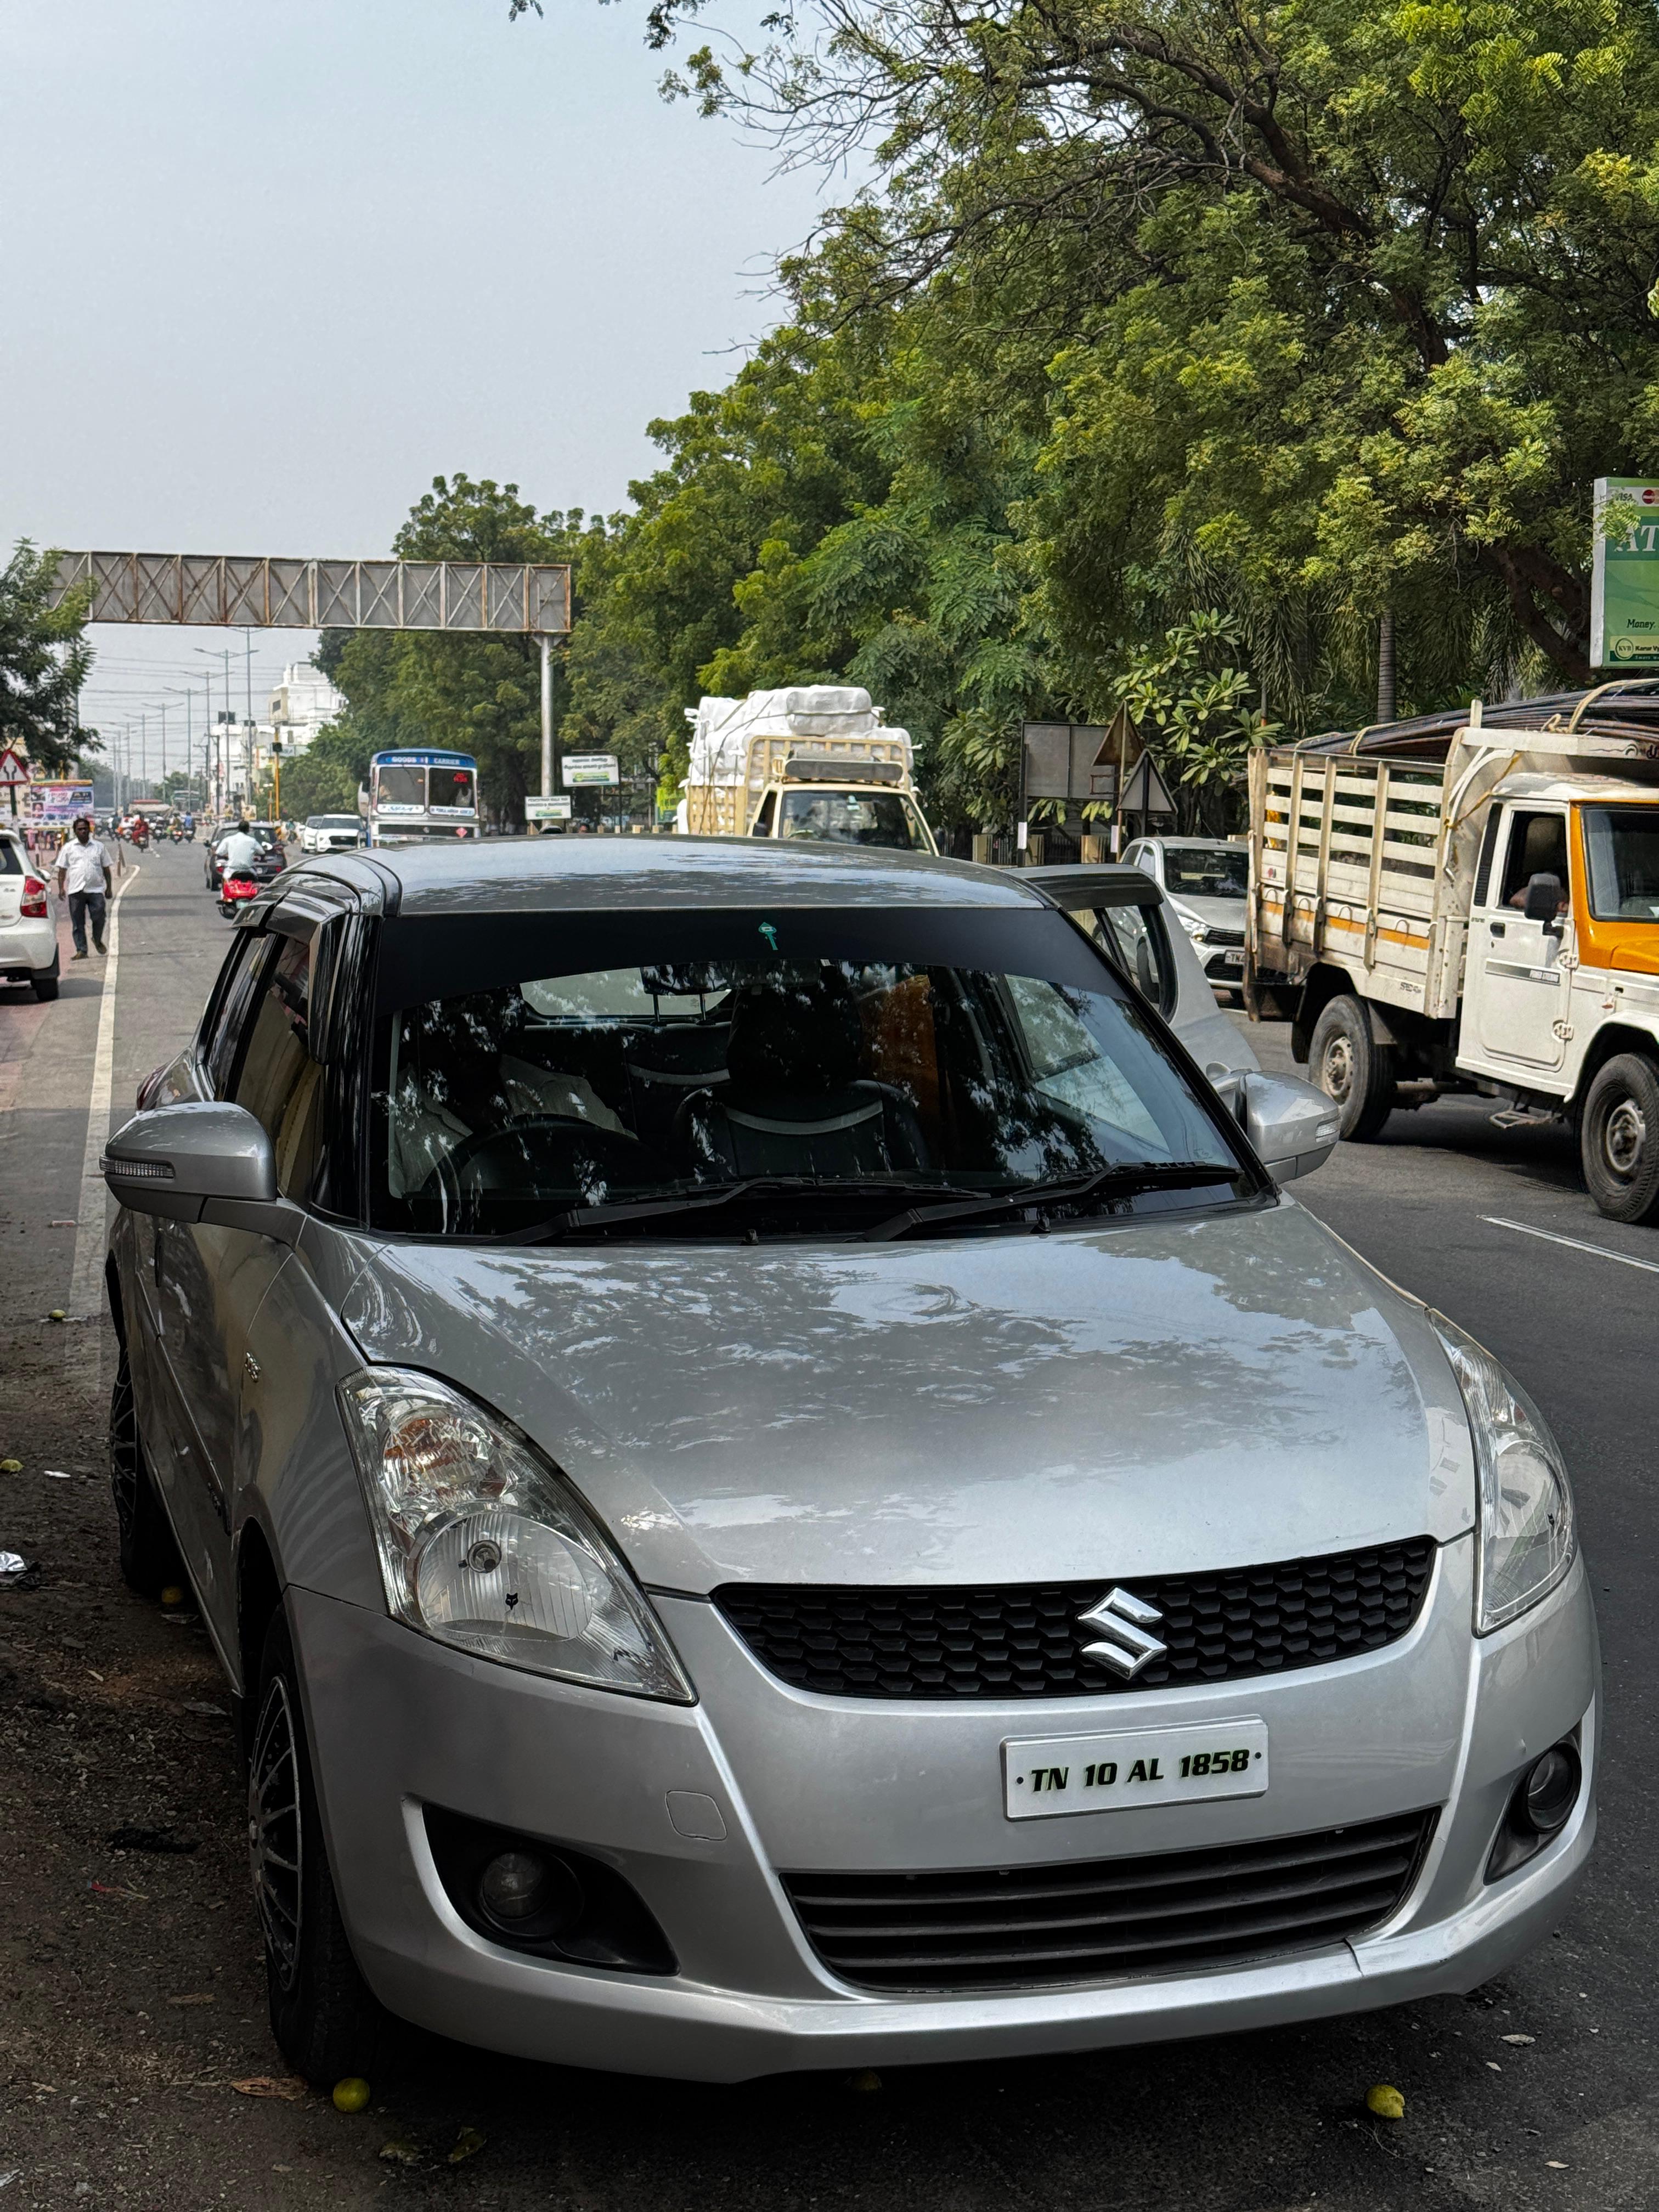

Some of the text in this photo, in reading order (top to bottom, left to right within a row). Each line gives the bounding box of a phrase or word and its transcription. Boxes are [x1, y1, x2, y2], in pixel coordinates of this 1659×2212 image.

[1627, 618, 1656, 630] Money.
[1031, 1749, 1250, 1792] TN 10 AL 1858
